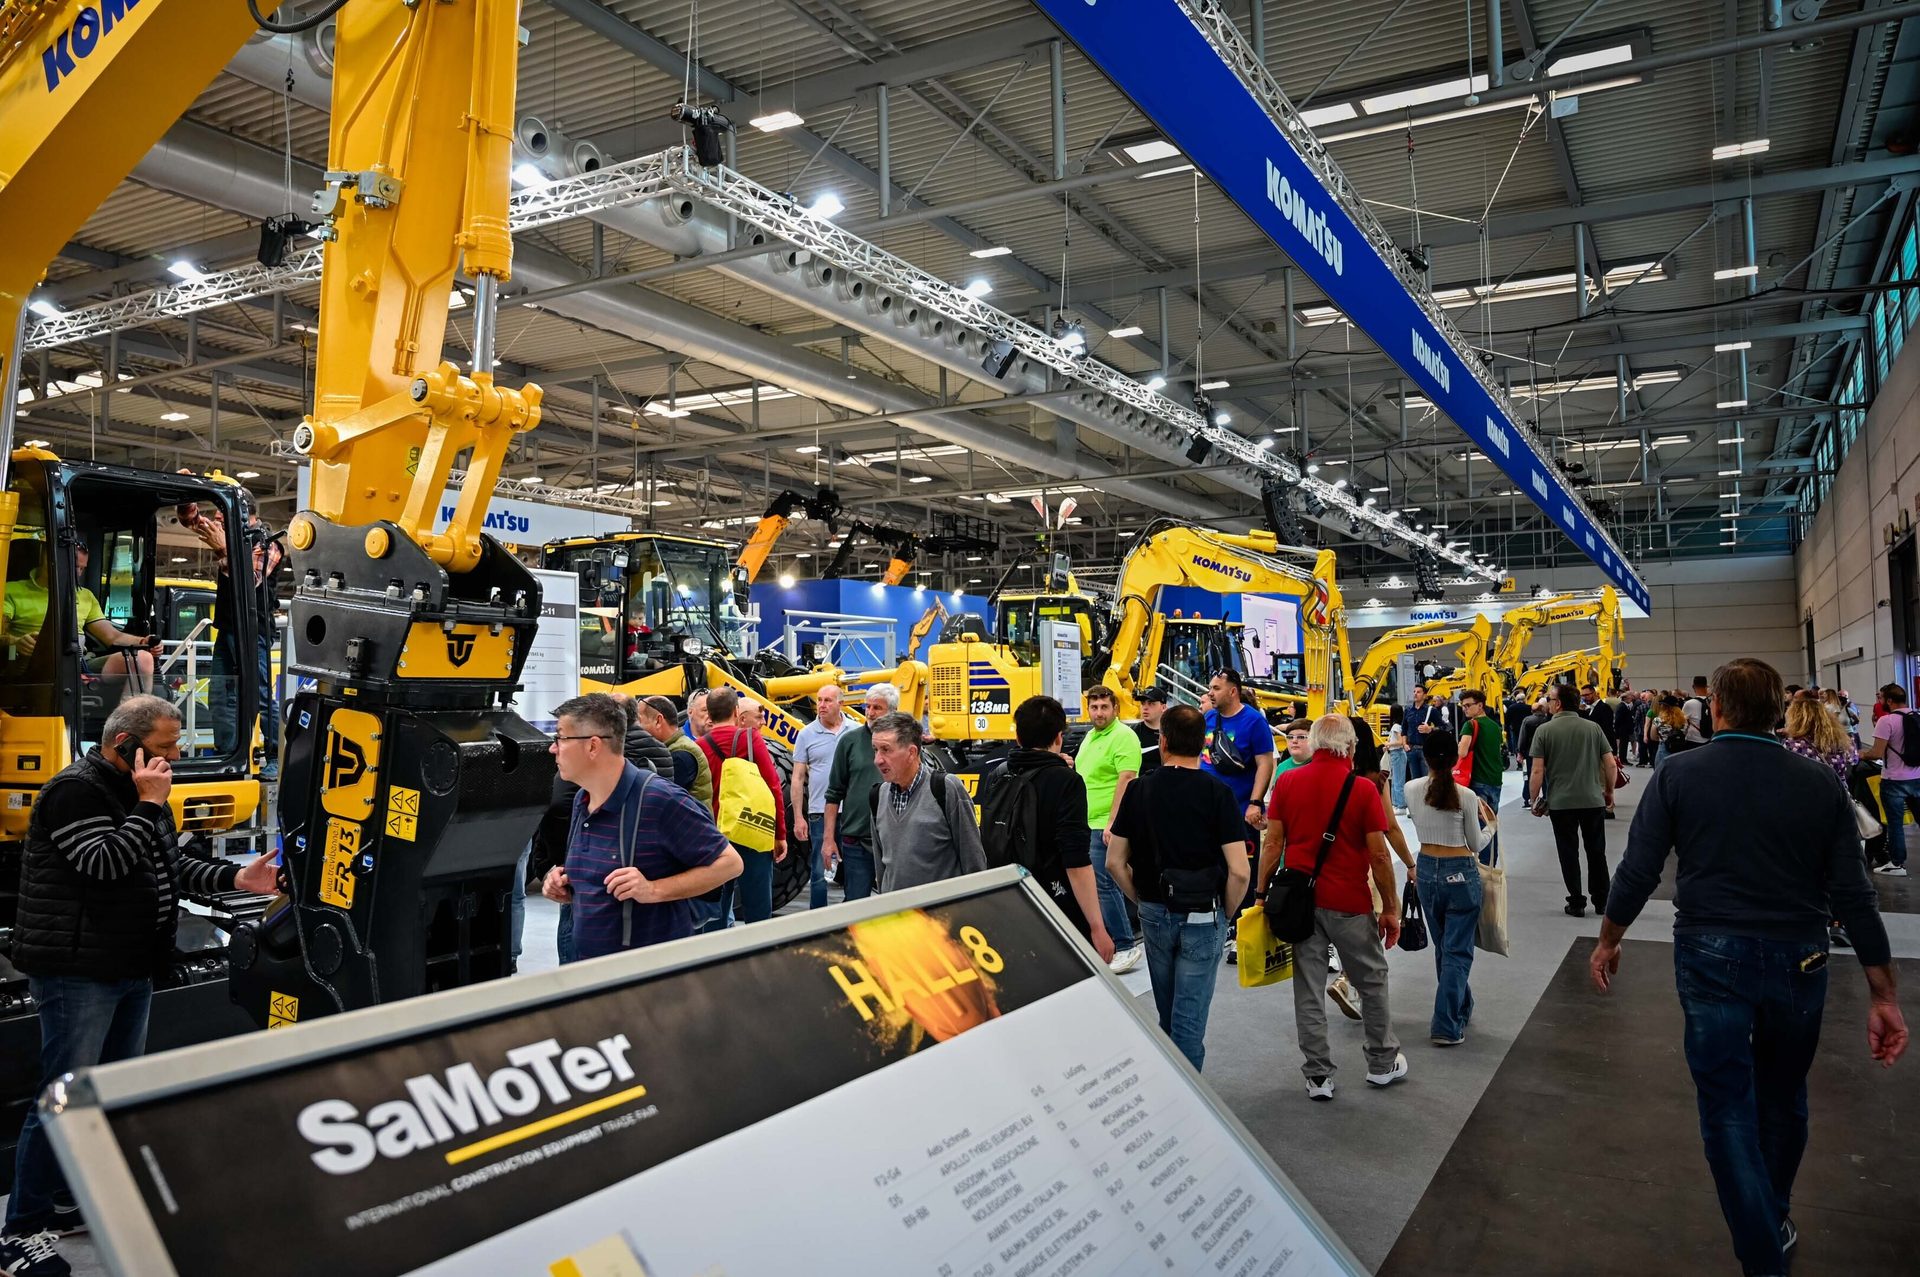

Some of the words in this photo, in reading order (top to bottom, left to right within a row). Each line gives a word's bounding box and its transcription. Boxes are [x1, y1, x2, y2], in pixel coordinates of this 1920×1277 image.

[1266, 157, 1343, 276] KOMATSU
[1412, 327, 1450, 394] KOMATSU
[442, 506, 529, 533] KATSU
[1192, 555, 1252, 582] KOMATSU
[1410, 610, 1458, 620] KOMATSU
[1551, 610, 1584, 620] KOMATSU
[1406, 638, 1444, 650] KOMATSU
[970, 701, 1010, 714] 138MR
[972, 691, 990, 700] PW
[978, 718, 986, 728] 30
[339, 828, 354, 854] 13
[334, 862, 352, 899] FR
[828, 940, 978, 1022] HALL
[960, 926, 1004, 973] 8
[297, 1034, 636, 1175] SaMoTer
[344, 1184, 454, 1230] INTERNATIONAL
[451, 1147, 544, 1192] CONSTRUCTION
[541, 1124, 602, 1158] EQUIPMENT
[601, 1113, 638, 1134] TRADE
[635, 1104, 660, 1120] FAIR
[940, 1152, 970, 1176] APOLLO
[968, 1139, 993, 1158] TYRES
[991, 1135, 1040, 1172] ASSOCIAZIONE
[987, 1219, 1012, 1242] AVANT
[1009, 1202, 1036, 1225] TECNO
[1024, 1216, 1056, 1243] SERVICE
[1044, 1218, 1090, 1258] ELETTRONICA
